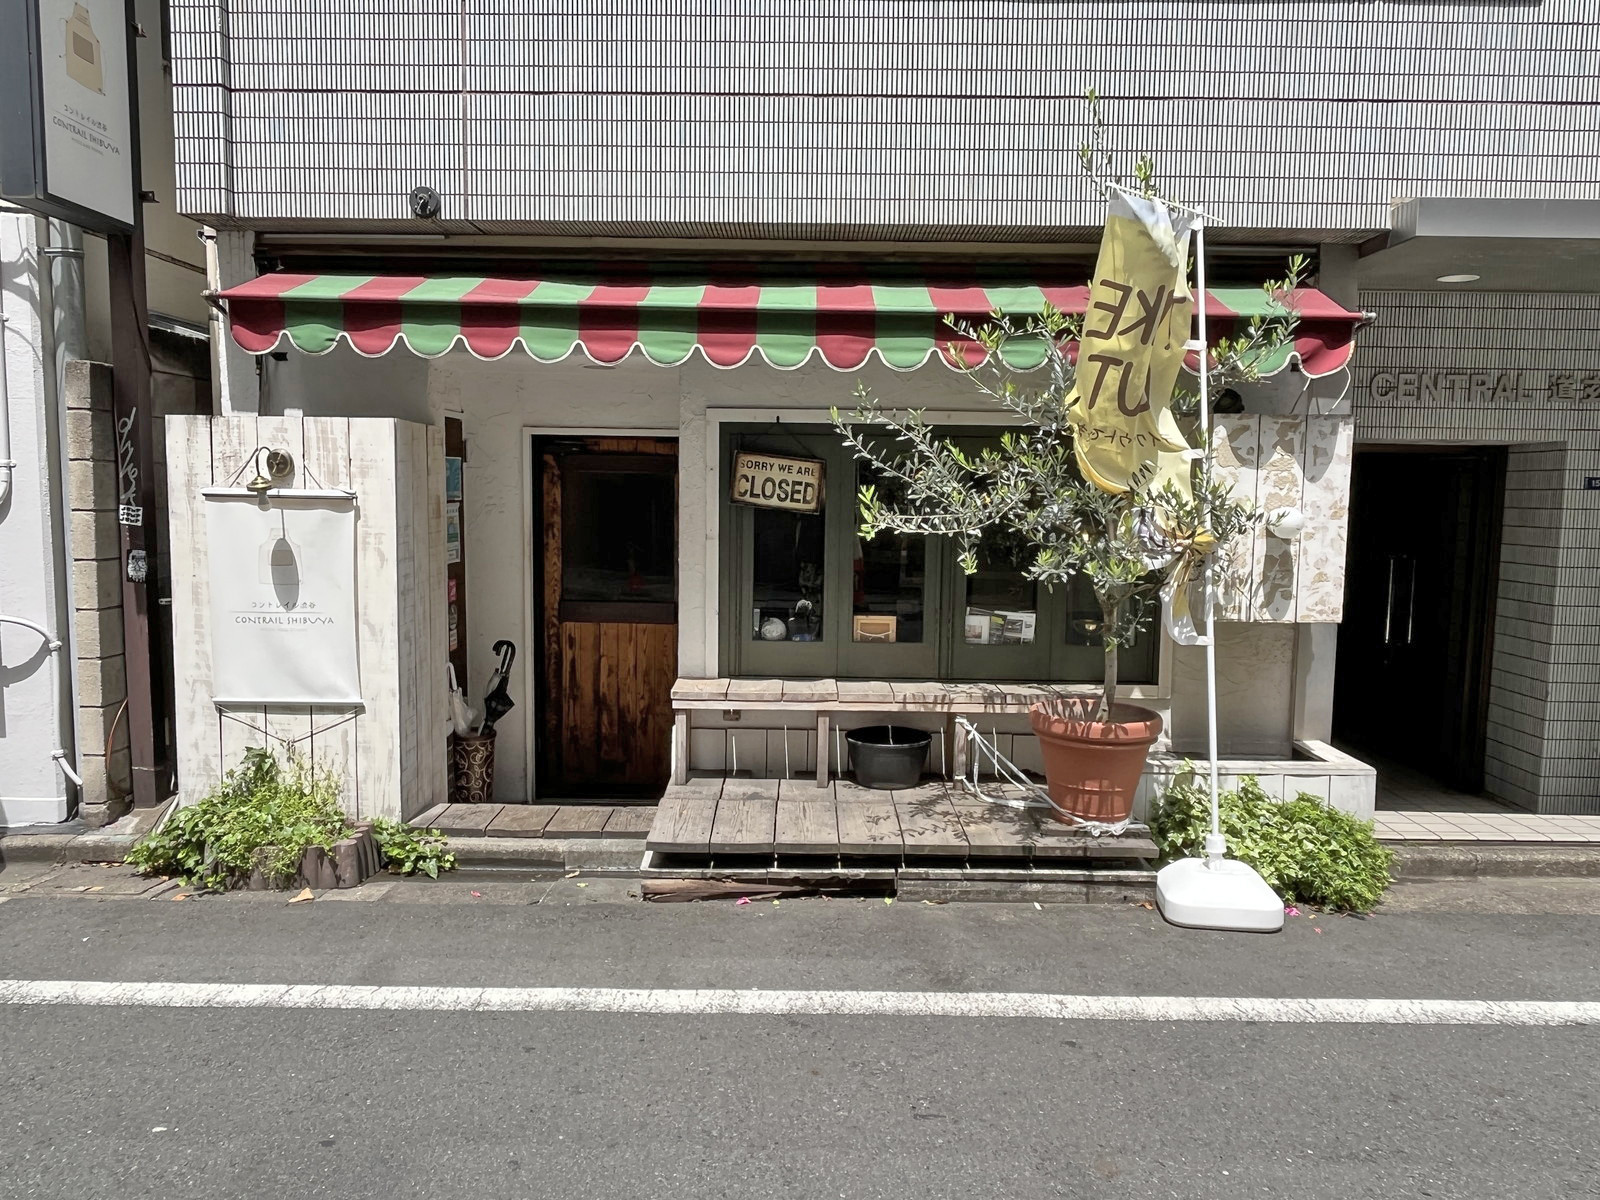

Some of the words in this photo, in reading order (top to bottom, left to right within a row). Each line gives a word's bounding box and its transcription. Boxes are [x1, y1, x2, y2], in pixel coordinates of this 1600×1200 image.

[53, 116, 88, 140] CONTRAIL
[1370, 372, 1533, 402] CENTRAL
[740, 459, 775, 471] SORRY
[778, 463, 793, 474] WE
[738, 474, 815, 504] CLOSED
[235, 616, 283, 625] CONTRAIL
[287, 616, 334, 625] SHIBUYA
